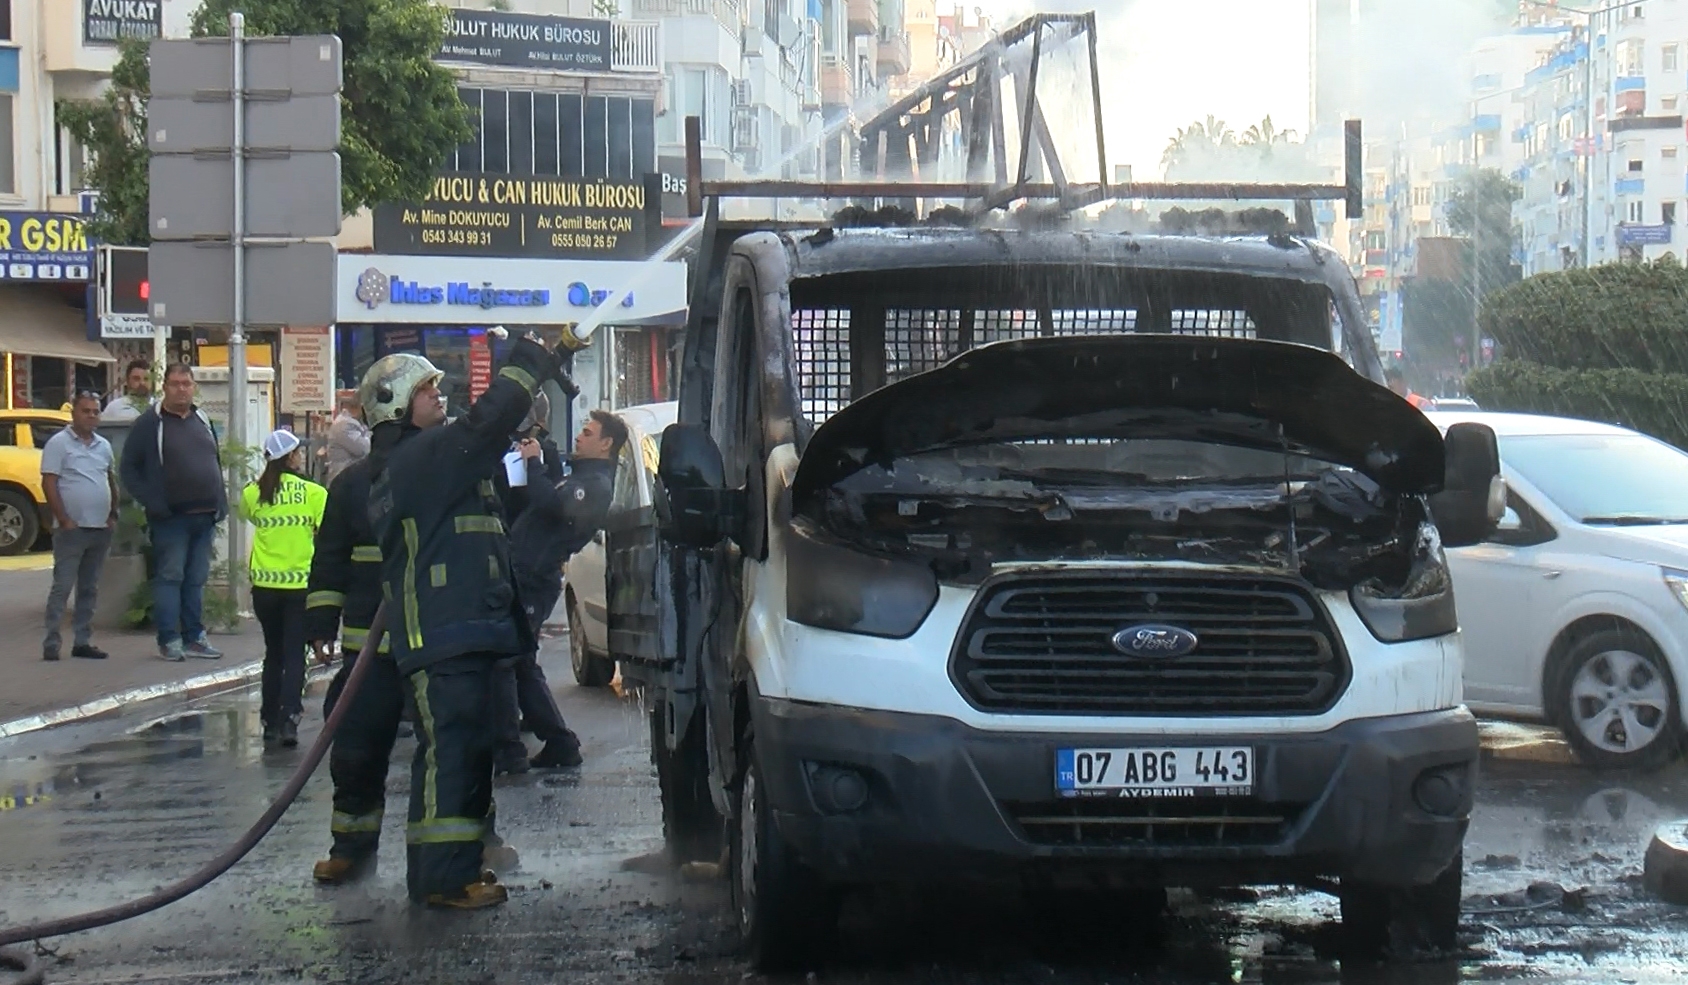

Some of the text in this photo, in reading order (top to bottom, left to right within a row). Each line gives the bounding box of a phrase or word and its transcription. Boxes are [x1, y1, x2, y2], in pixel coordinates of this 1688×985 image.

[89, 0, 157, 20] AVUKAT
[442, 19, 601, 45] BULUT HUKUK BÜROSU
[479, 178, 490, 203] &
[493, 179, 526, 204] CAN
[531, 181, 582, 207] HUKUK
[585, 178, 646, 210] BÜROSU
[662, 173, 687, 195] Baş
[402, 209, 510, 227] Av. Mine DOKUYUCU
[537, 214, 632, 232] Av. Cemil Berk CAN
[21, 217, 88, 252] GSM
[422, 229, 491, 246] 0543 343 99 31
[552, 233, 573, 247] 0555
[135, 325, 144, 334] VE
[1132, 629, 1178, 650] Ford
[1061, 750, 1248, 784] TR 07 ABG 443
[1119, 788, 1195, 797] AYDEMİR
